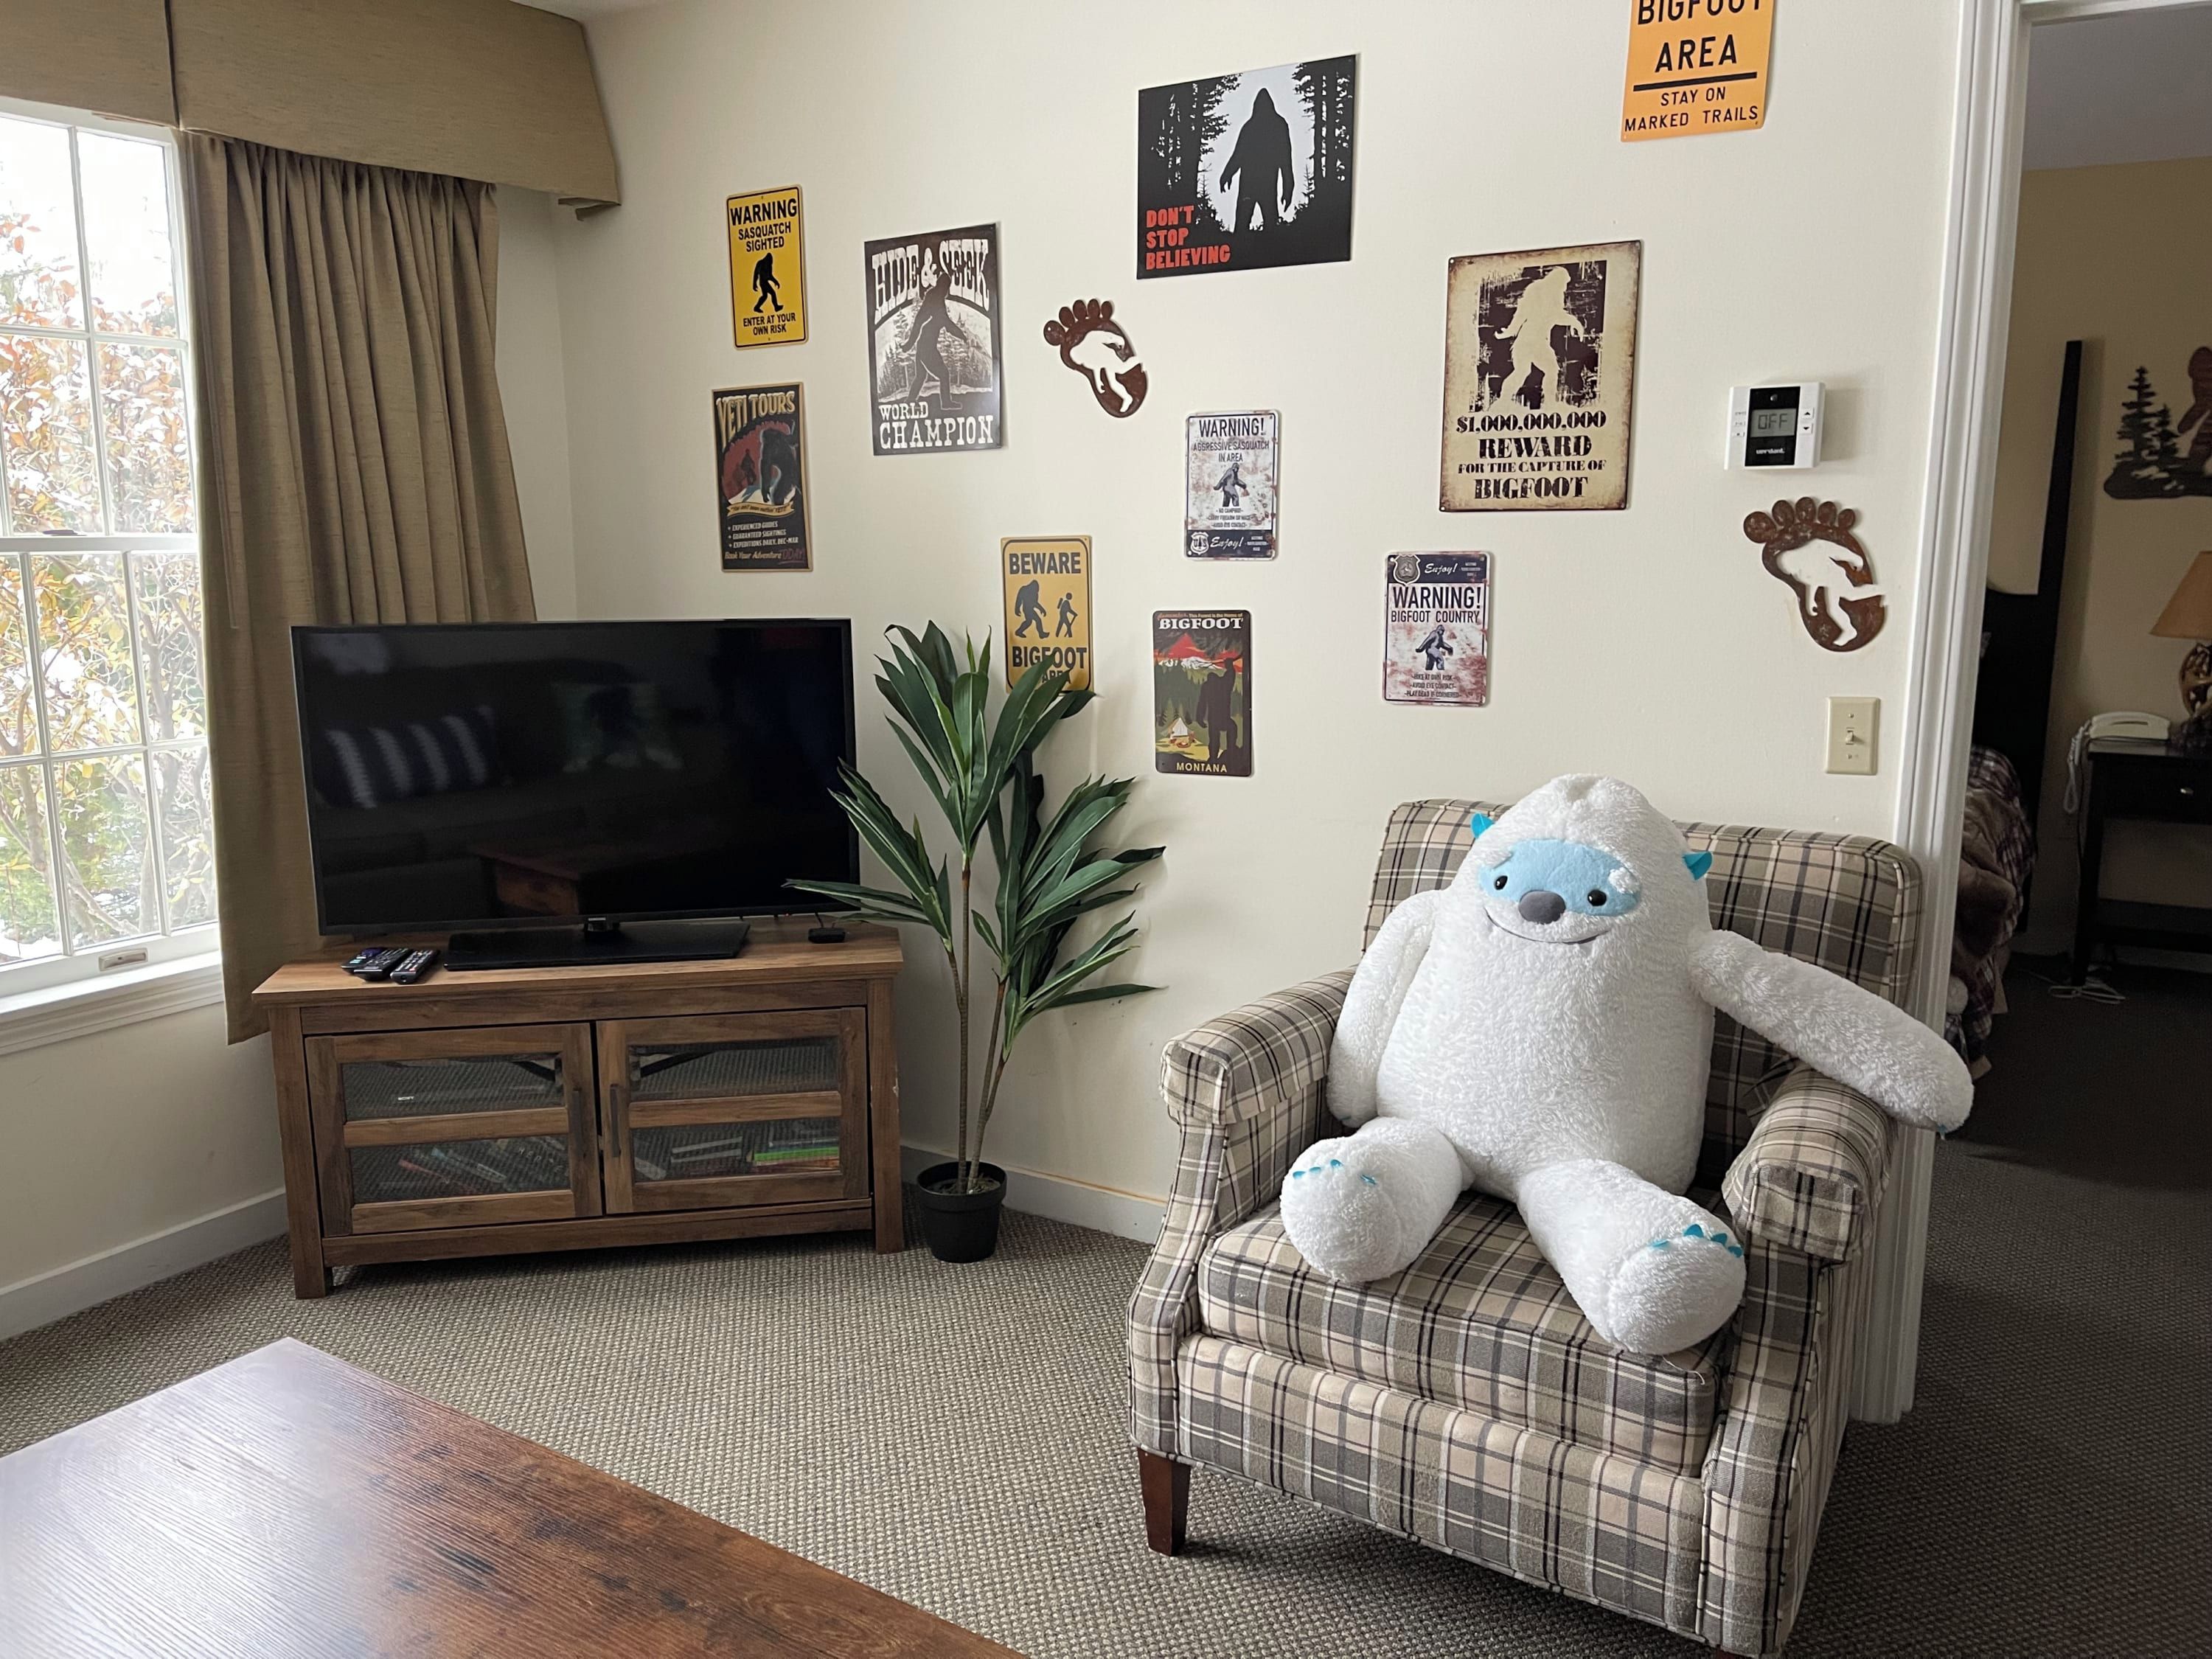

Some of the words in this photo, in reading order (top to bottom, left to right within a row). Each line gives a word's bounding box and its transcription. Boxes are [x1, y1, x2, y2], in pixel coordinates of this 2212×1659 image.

[1655, 34, 1737, 73] AREA
[1660, 89, 1698, 107] STAY
[1705, 86, 1726, 102] ON
[1624, 112, 1688, 132] MARKED
[1703, 105, 1759, 124] TRAILS
[730, 198, 797, 226] WARNING
[1146, 205, 1194, 228] DON'T
[738, 221, 791, 240] SASQUATCH
[1146, 228, 1189, 249] STOP
[746, 236, 785, 252] SIGHTED
[1146, 244, 1231, 270] BELIEVING
[872, 244, 920, 324] HIDE
[921, 248, 937, 288] &
[939, 239, 990, 311] SEEK
[743, 316, 765, 327] ENTER
[767, 314, 776, 325] AT
[778, 313, 796, 324] YOUR
[753, 326, 769, 335] OWN
[771, 324, 787, 334] RISK
[879, 401, 928, 420] WORLD
[716, 394, 748, 453] YETI
[748, 391, 796, 420] TOURS
[880, 415, 993, 449] CHAMPION
[1199, 417, 1265, 438] WARNING!
[1758, 414, 1787, 430] OFF
[1193, 442, 1231, 451] AGGRESSIVE
[1234, 440, 1270, 451] SASQUATCH
[1478, 435, 1592, 459] REWARD
[1219, 453, 1225, 462] IN
[1227, 452, 1243, 462] AREA
[1458, 463, 1484, 474] FOR
[1487, 462, 1516, 473] THE
[1518, 460, 1585, 473] CAPTURE
[1587, 459, 1607, 471] OF
[1474, 476, 1588, 499] BIGFOOT
[1210, 536, 1244, 549] Enjoy!
[1009, 552, 1081, 574] BEWARE
[1425, 563, 1458, 575] Enjoy!
[1392, 586, 1481, 609] WARNING!
[1159, 618, 1243, 629] BIGFOOT
[1391, 611, 1431, 622] BIGFOOT
[1436, 611, 1480, 623] COUNTRY
[1012, 646, 1087, 669] BIGFOOT
[1176, 762, 1228, 773] MONTANA
